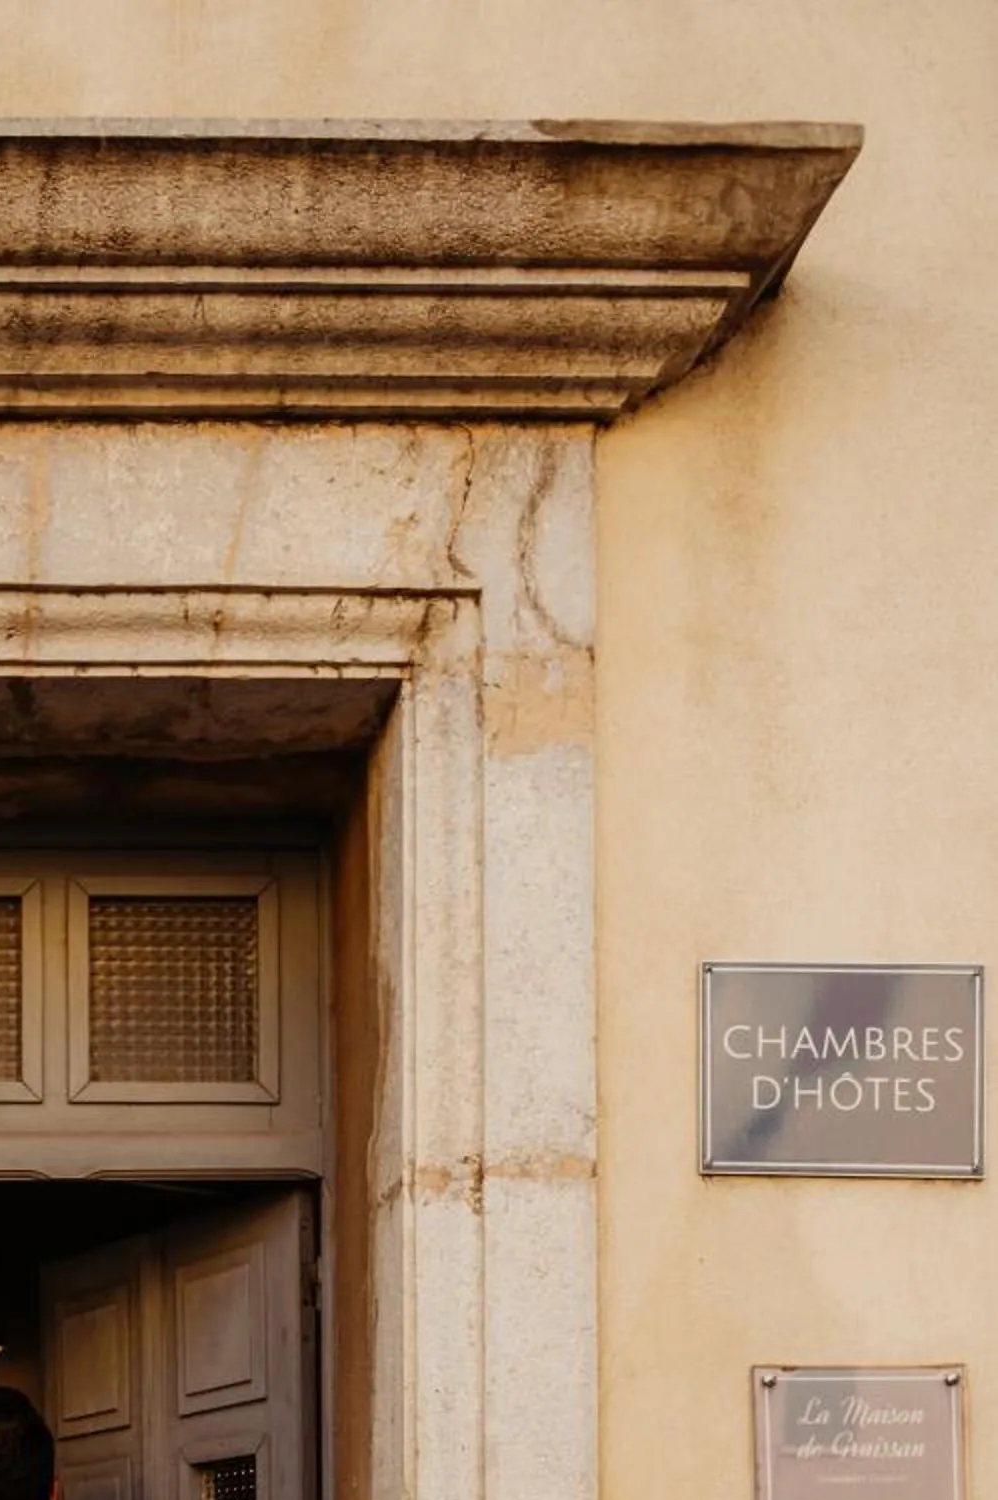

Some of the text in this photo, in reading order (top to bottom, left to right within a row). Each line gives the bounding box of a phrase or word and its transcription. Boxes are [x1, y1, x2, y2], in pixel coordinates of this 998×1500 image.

[723, 1024, 965, 1062] CHAMBRES
[752, 1071, 936, 1113] D'HÔTES
[796, 1396, 925, 1428] La Maison
[831, 1431, 926, 1459] Gruissan
